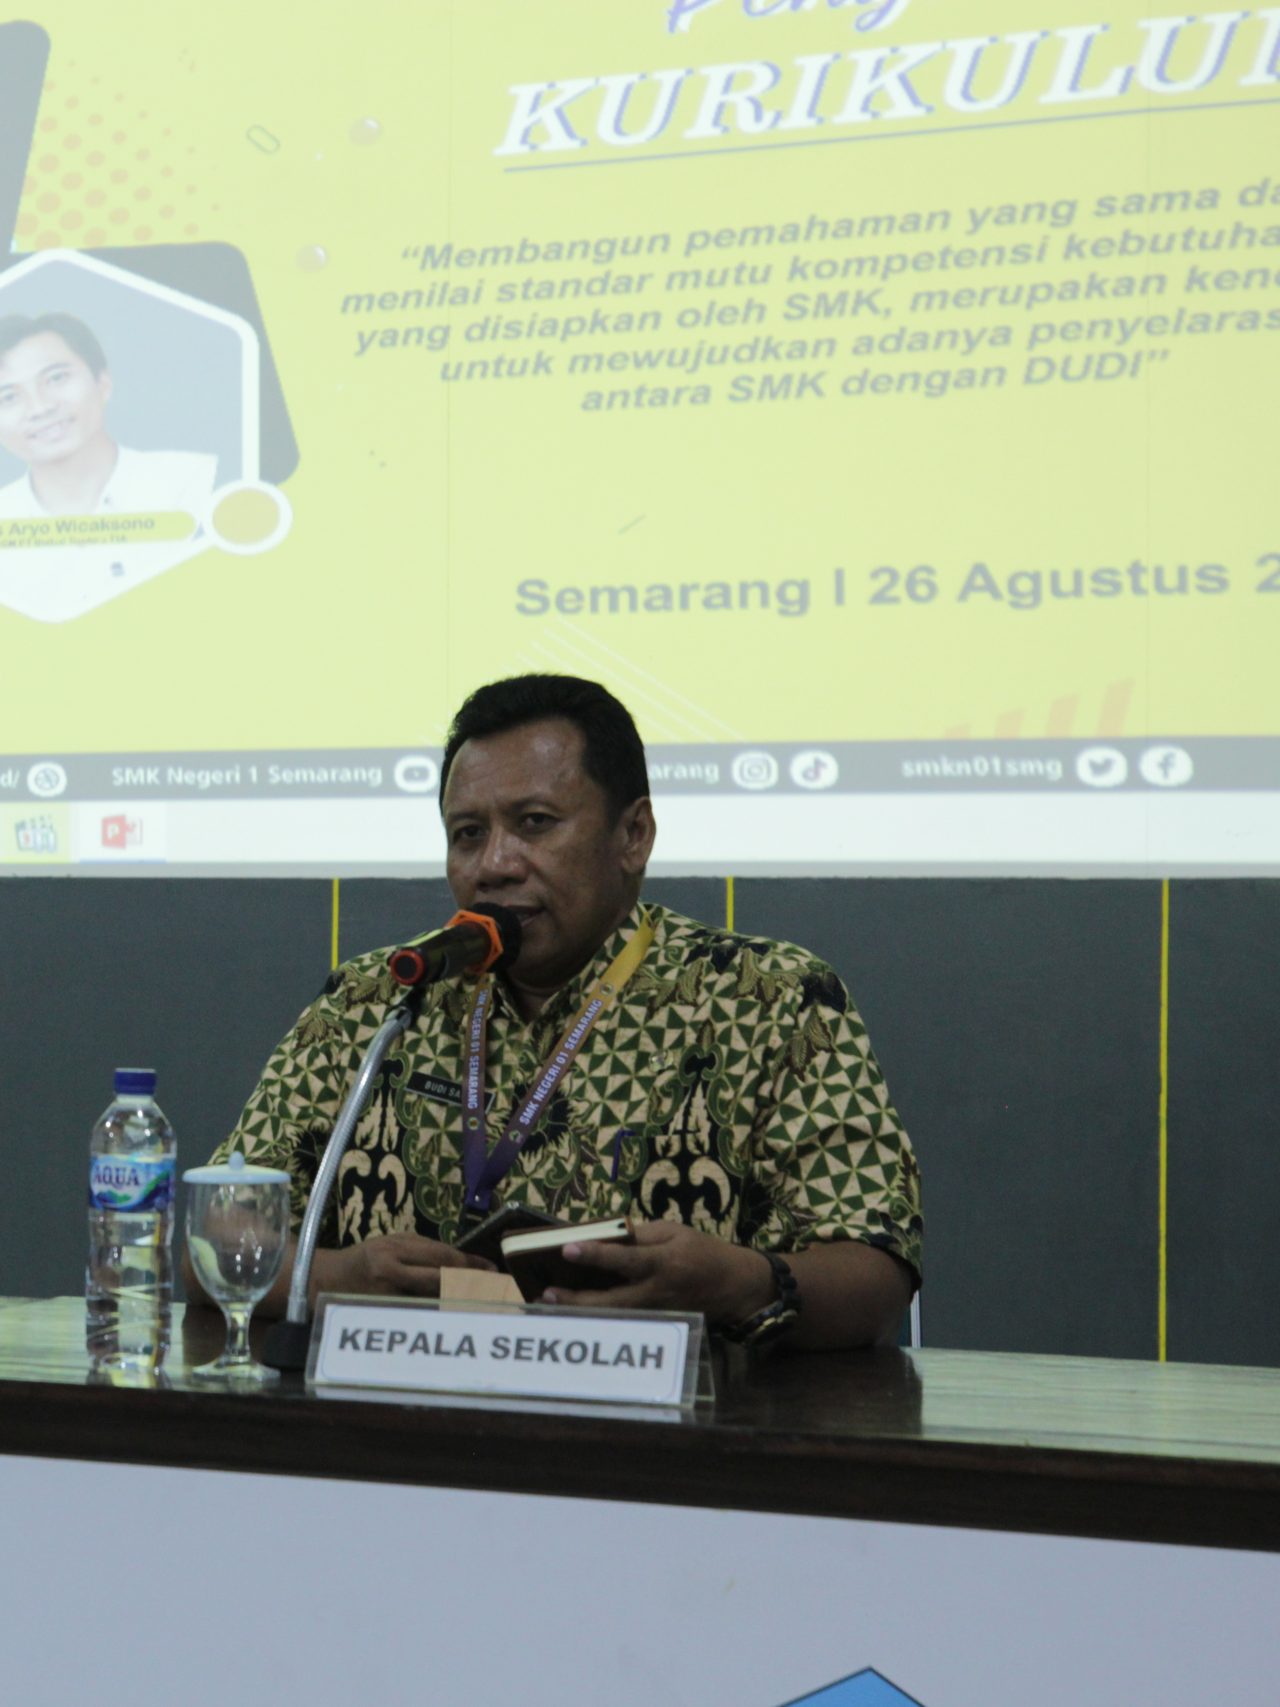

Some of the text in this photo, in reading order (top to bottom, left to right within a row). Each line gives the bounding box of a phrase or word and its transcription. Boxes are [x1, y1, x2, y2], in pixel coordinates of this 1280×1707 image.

[683, 209, 952, 258] pemahaman
[966, 199, 1078, 235] yang
[1094, 187, 1219, 218] sama
[341, 279, 484, 315] menilai
[497, 270, 653, 304] standar
[665, 260, 772, 292] mutu
[787, 235, 1050, 281] kompetensi
[354, 324, 450, 357] yang
[465, 308, 662, 343] disiapkan
[676, 298, 767, 328] oleh
[782, 288, 892, 321] SMK,
[910, 272, 1167, 313] merupakan
[440, 350, 554, 382] untuk
[568, 335, 837, 375] mewujudkan
[852, 325, 1013, 357] adanya
[581, 382, 712, 412] antara
[727, 371, 828, 404] SMK
[840, 364, 1008, 399] dengan
[8, 521, 50, 538] Aryo
[56, 517, 155, 534] Wicaksono
[516, 575, 811, 617] Semarang
[869, 565, 939, 605] 26
[958, 560, 1230, 609] Agustus
[112, 763, 382, 789] SMK Negeri 1 Semarang
[467, 1054, 480, 1109] SEMARANG
[519, 999, 603, 1126] SMK NEGERI 01 SEMARANG
[94, 1164, 140, 1189] AQUA
[338, 1327, 665, 1370] KEPALA SEKOLAH
